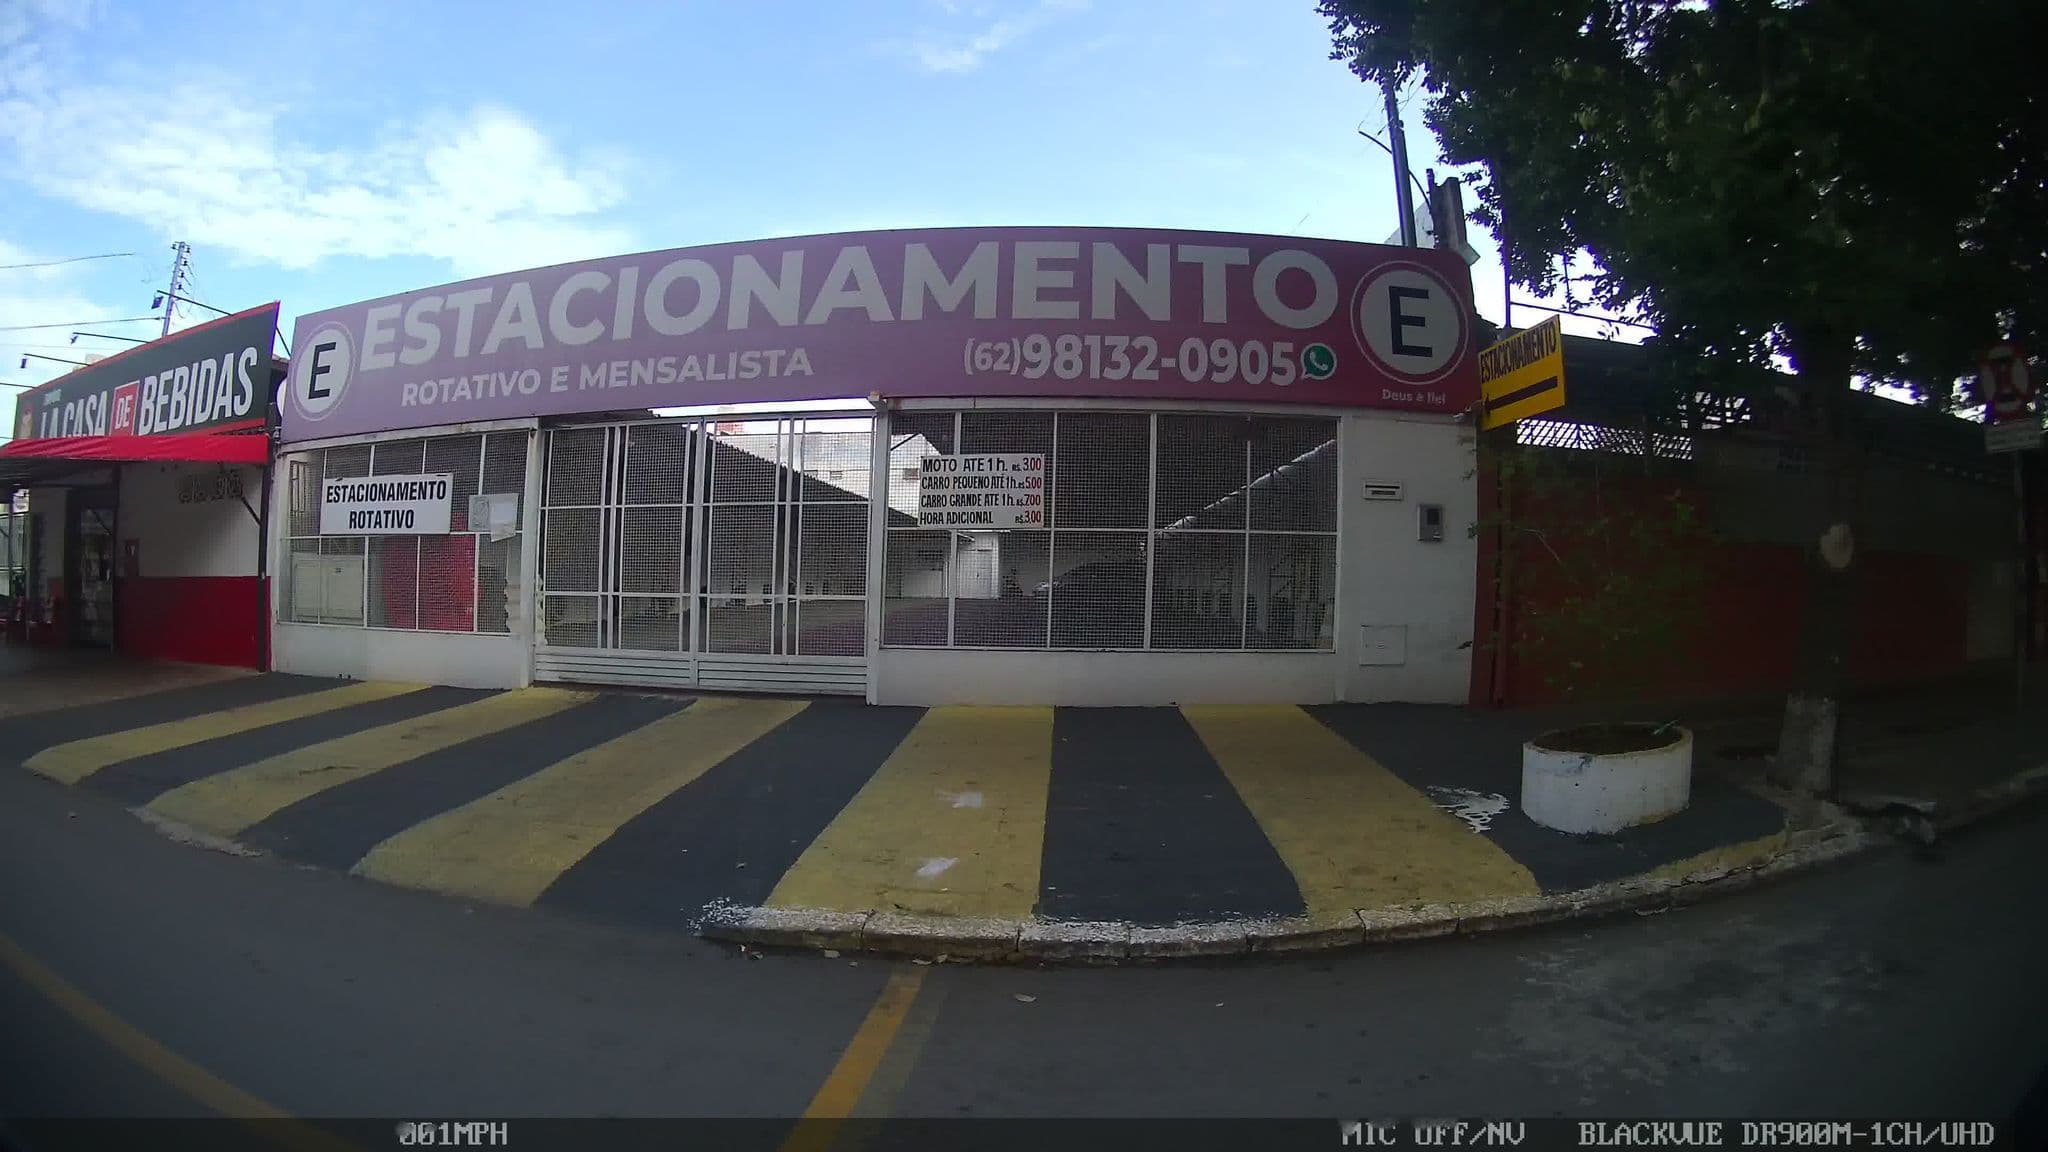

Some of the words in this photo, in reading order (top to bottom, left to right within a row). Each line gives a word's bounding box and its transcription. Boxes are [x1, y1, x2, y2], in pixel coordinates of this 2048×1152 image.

[359, 240, 1339, 371] ESTACIONAMENTO
[1387, 285, 1433, 358] E
[307, 341, 338, 400] E
[1480, 319, 1557, 384] ESTACIONAMENTO
[62, 390, 109, 437] CASA
[114, 393, 132, 430] DE
[138, 346, 259, 436] BEBIDAS
[401, 366, 542, 408] ROTATIVO
[550, 365, 569, 393] E
[579, 347, 816, 390] MENSALISTA
[921, 477, 950, 490] CARRO
[953, 476, 989, 489] PEQUENO
[922, 458, 957, 472] MOTO
[326, 480, 447, 503] ESTACIONAMENTO
[921, 494, 947, 508] CARRO
[949, 493, 982, 507] GRANDE
[349, 509, 415, 529] ROTATIVO
[919, 511, 944, 525] HORA
[946, 511, 994, 524] ADICIONAL
